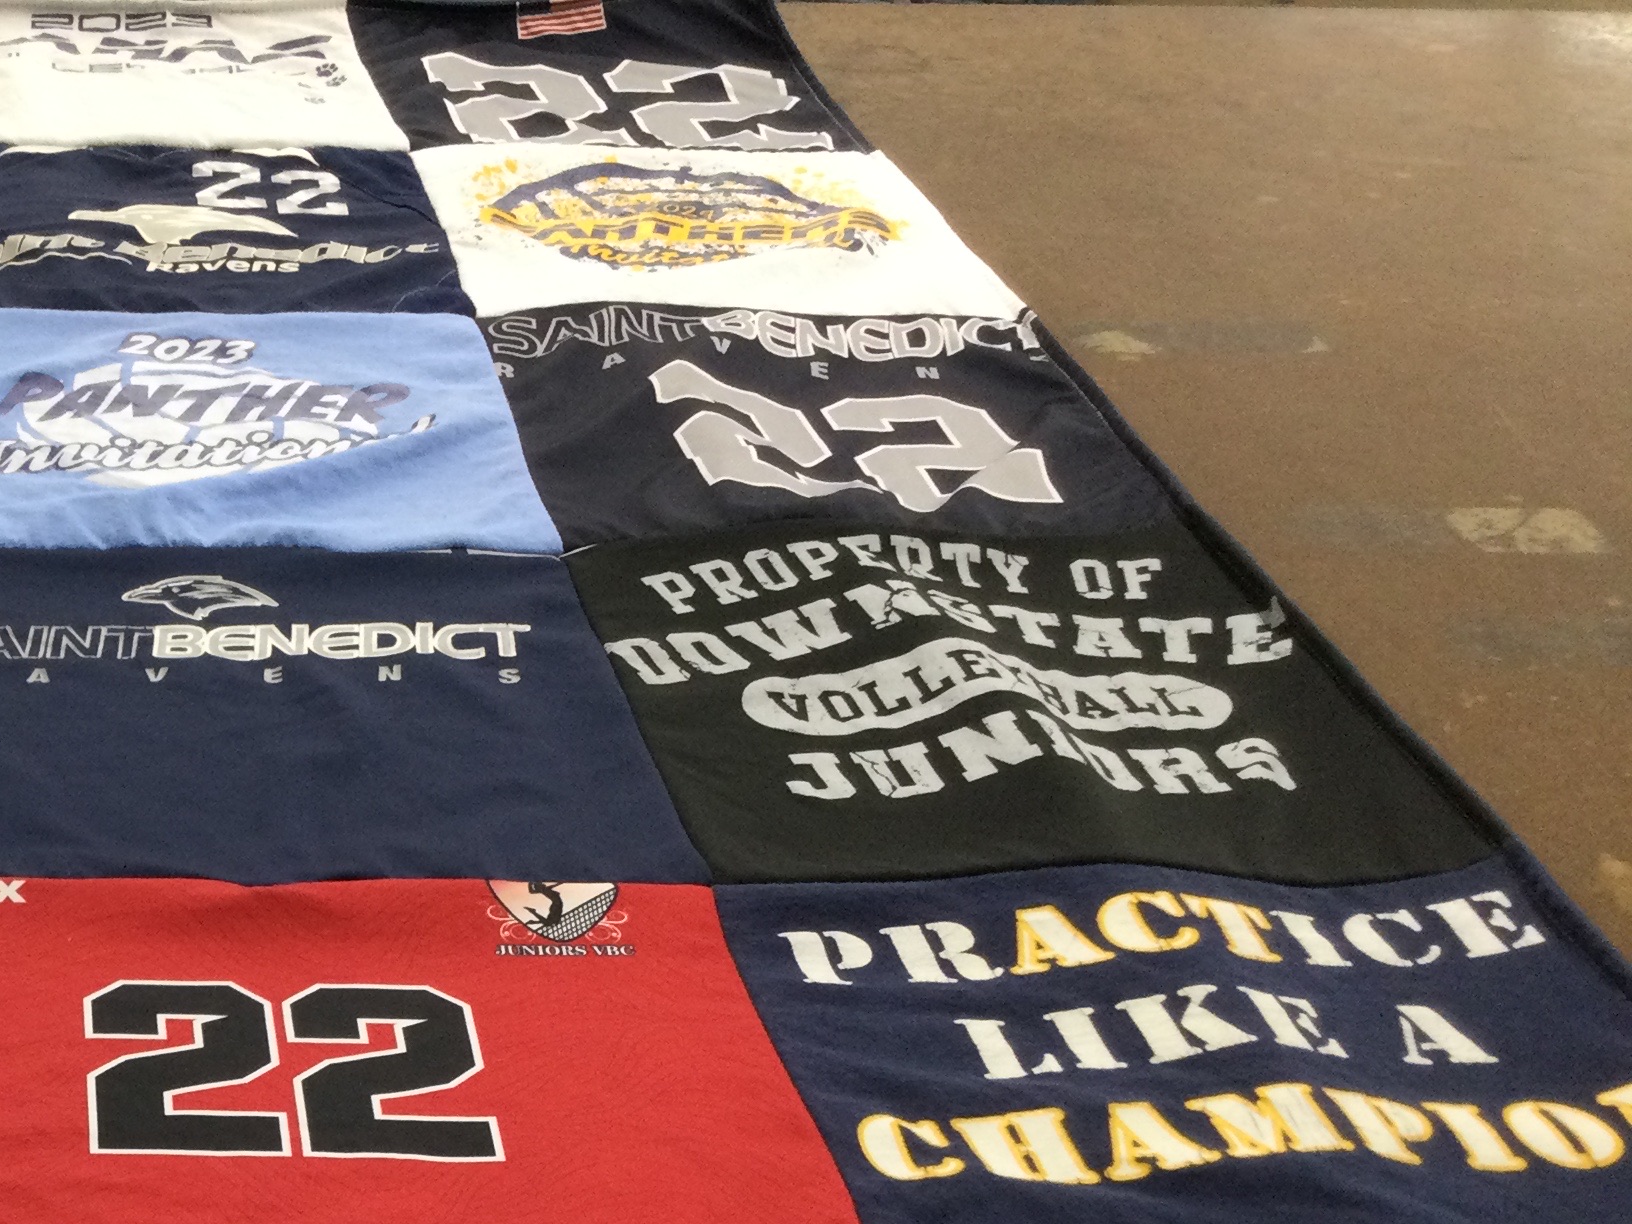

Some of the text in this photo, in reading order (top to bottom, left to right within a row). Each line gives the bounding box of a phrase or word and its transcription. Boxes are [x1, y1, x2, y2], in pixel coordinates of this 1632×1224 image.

[192, 161, 349, 216] 22
[119, 332, 257, 364] 2023
[640, 534, 1162, 615] PROPERTY OF
[603, 578, 1295, 686] DOWNSTATE
[495, 943, 636, 957] JUNIORS VBC
[778, 889, 1547, 987] PRACTICE
[83, 979, 507, 1163] 22
[953, 983, 1500, 1081] LIKE A
